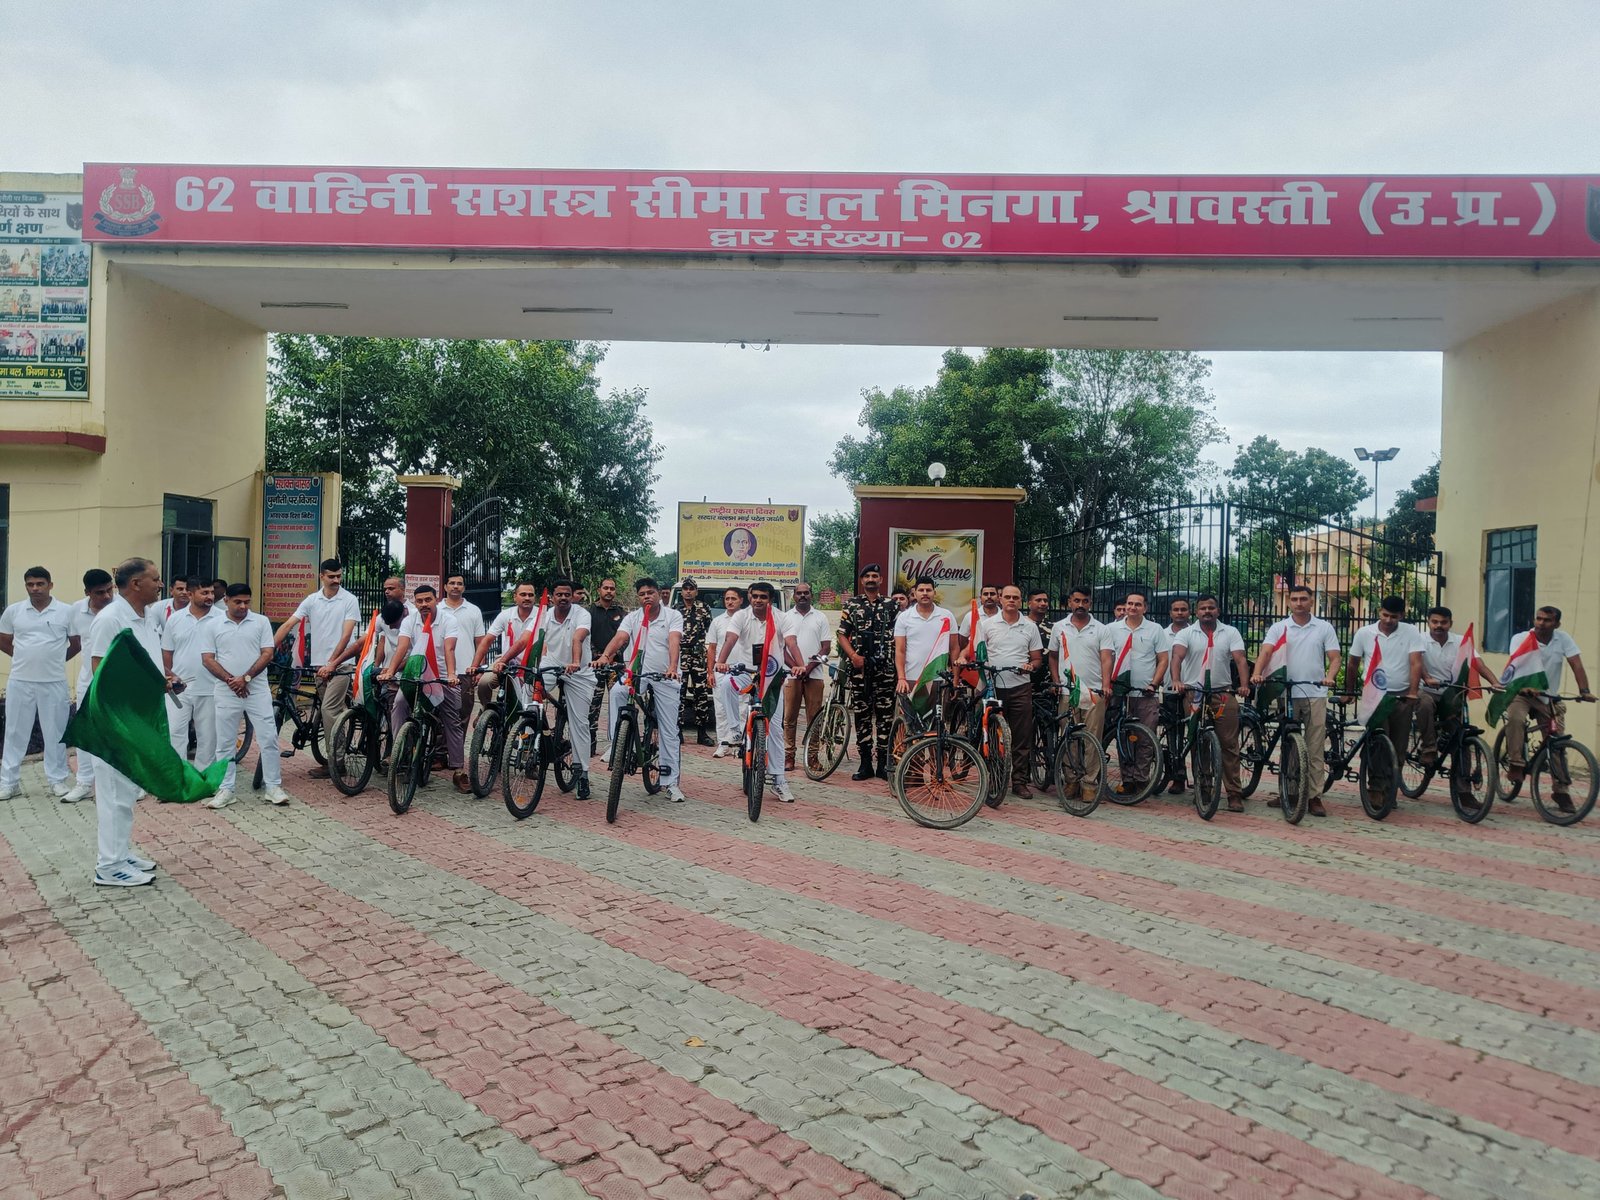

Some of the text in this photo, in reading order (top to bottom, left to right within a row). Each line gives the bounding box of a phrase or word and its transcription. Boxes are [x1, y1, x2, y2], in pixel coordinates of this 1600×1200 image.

[115, 192, 141, 210] SSB
[175, 172, 1557, 235] 62 वाहिनी सशस्त्र सीमा बल भिनगा, श्रावस्ती (उ.प्र.)
[23, 205, 35, 218] के
[38, 208, 60, 218] साथ
[16, 223, 43, 235] क्षण
[708, 228, 779, 248] द्वार
[942, 231, 983, 249] 02
[289, 496, 298, 505] पर
[298, 493, 318, 505] विजय
[708, 506, 731, 515] राष्ट्रीय
[755, 507, 775, 515] दिवस
[902, 554, 973, 581] Welcome
